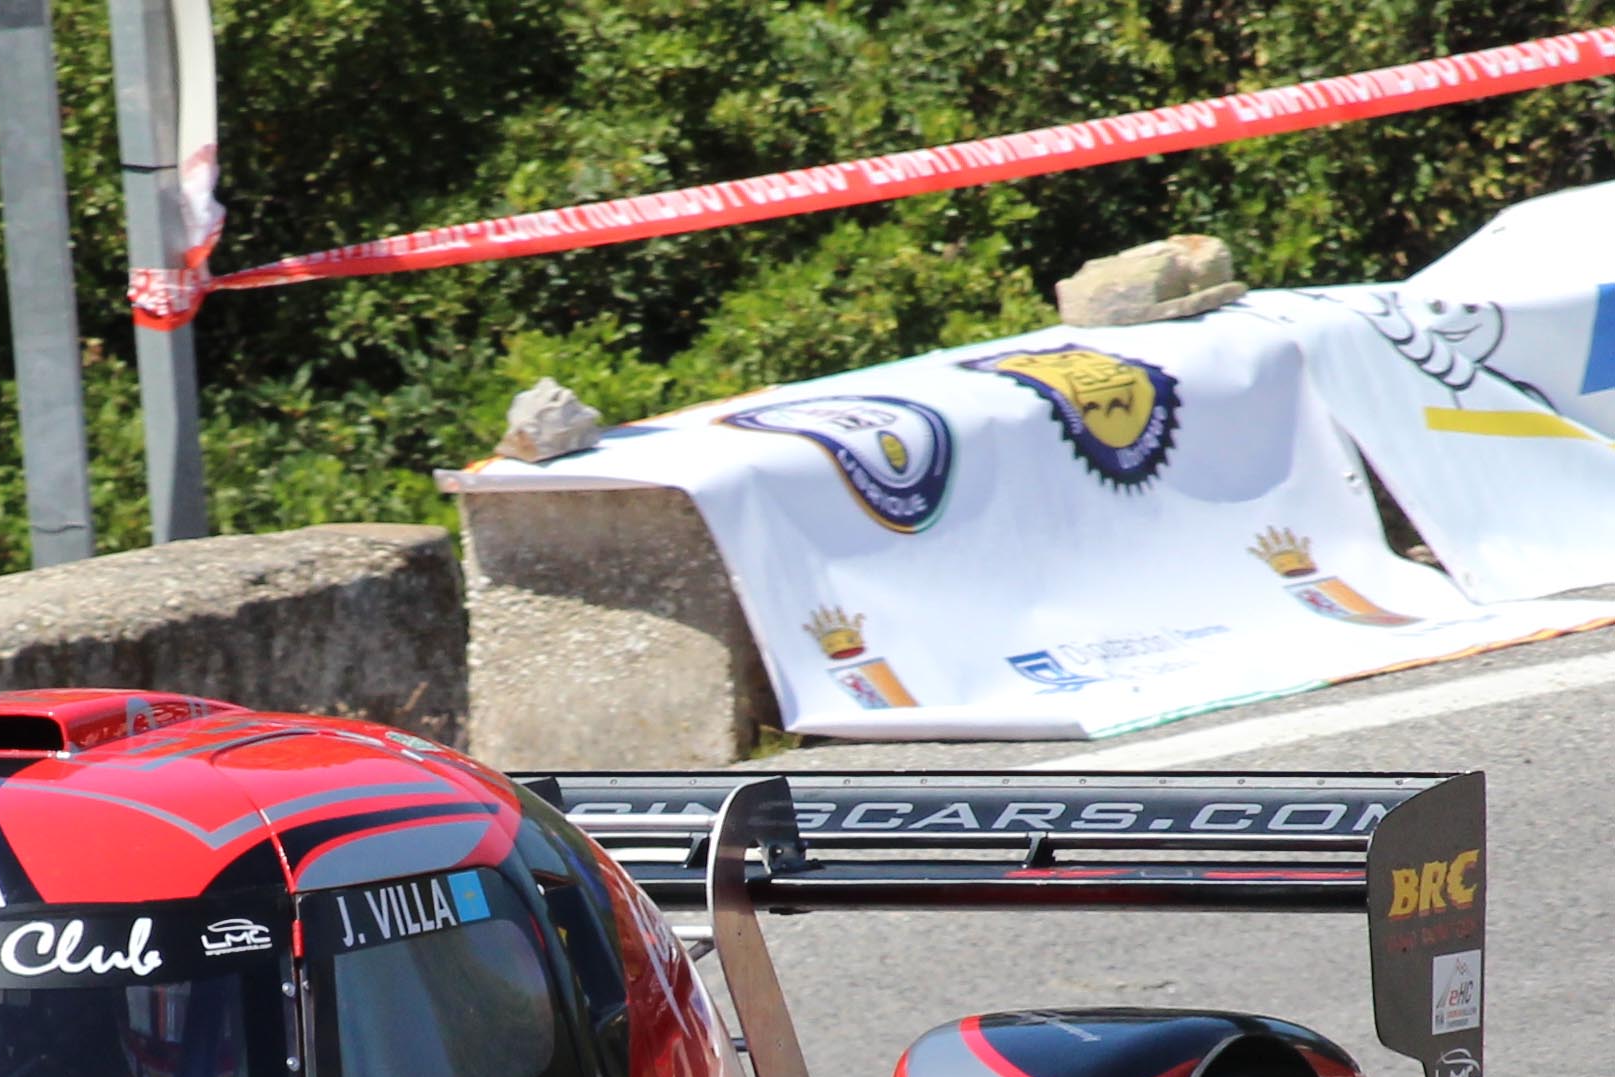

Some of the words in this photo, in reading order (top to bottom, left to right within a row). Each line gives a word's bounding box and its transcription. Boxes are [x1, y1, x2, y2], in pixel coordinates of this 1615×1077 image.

[336, 896, 366, 947] J.
[364, 879, 458, 939] VILLA
[1388, 849, 1480, 918] BRC
[0, 917, 163, 976] Club
